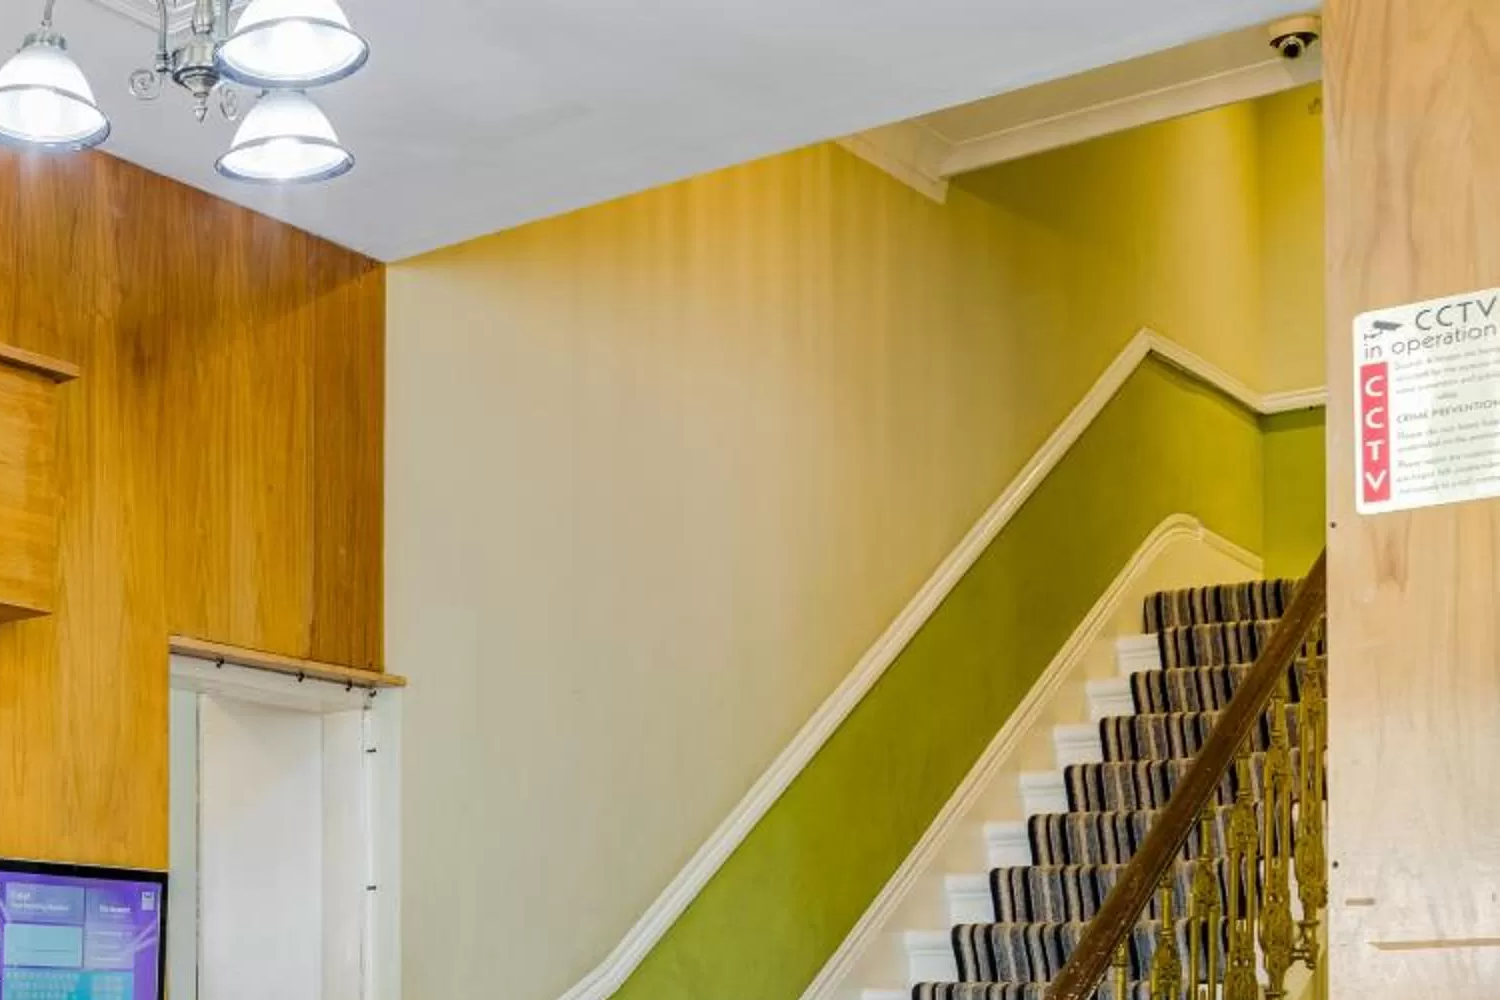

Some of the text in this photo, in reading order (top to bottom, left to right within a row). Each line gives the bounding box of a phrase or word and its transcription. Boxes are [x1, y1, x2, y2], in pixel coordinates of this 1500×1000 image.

[1415, 296, 1497, 331] CCTV
[1364, 343, 1383, 359] in
[1392, 323, 1497, 355] operation
[1364, 375, 1388, 492] CCTV
